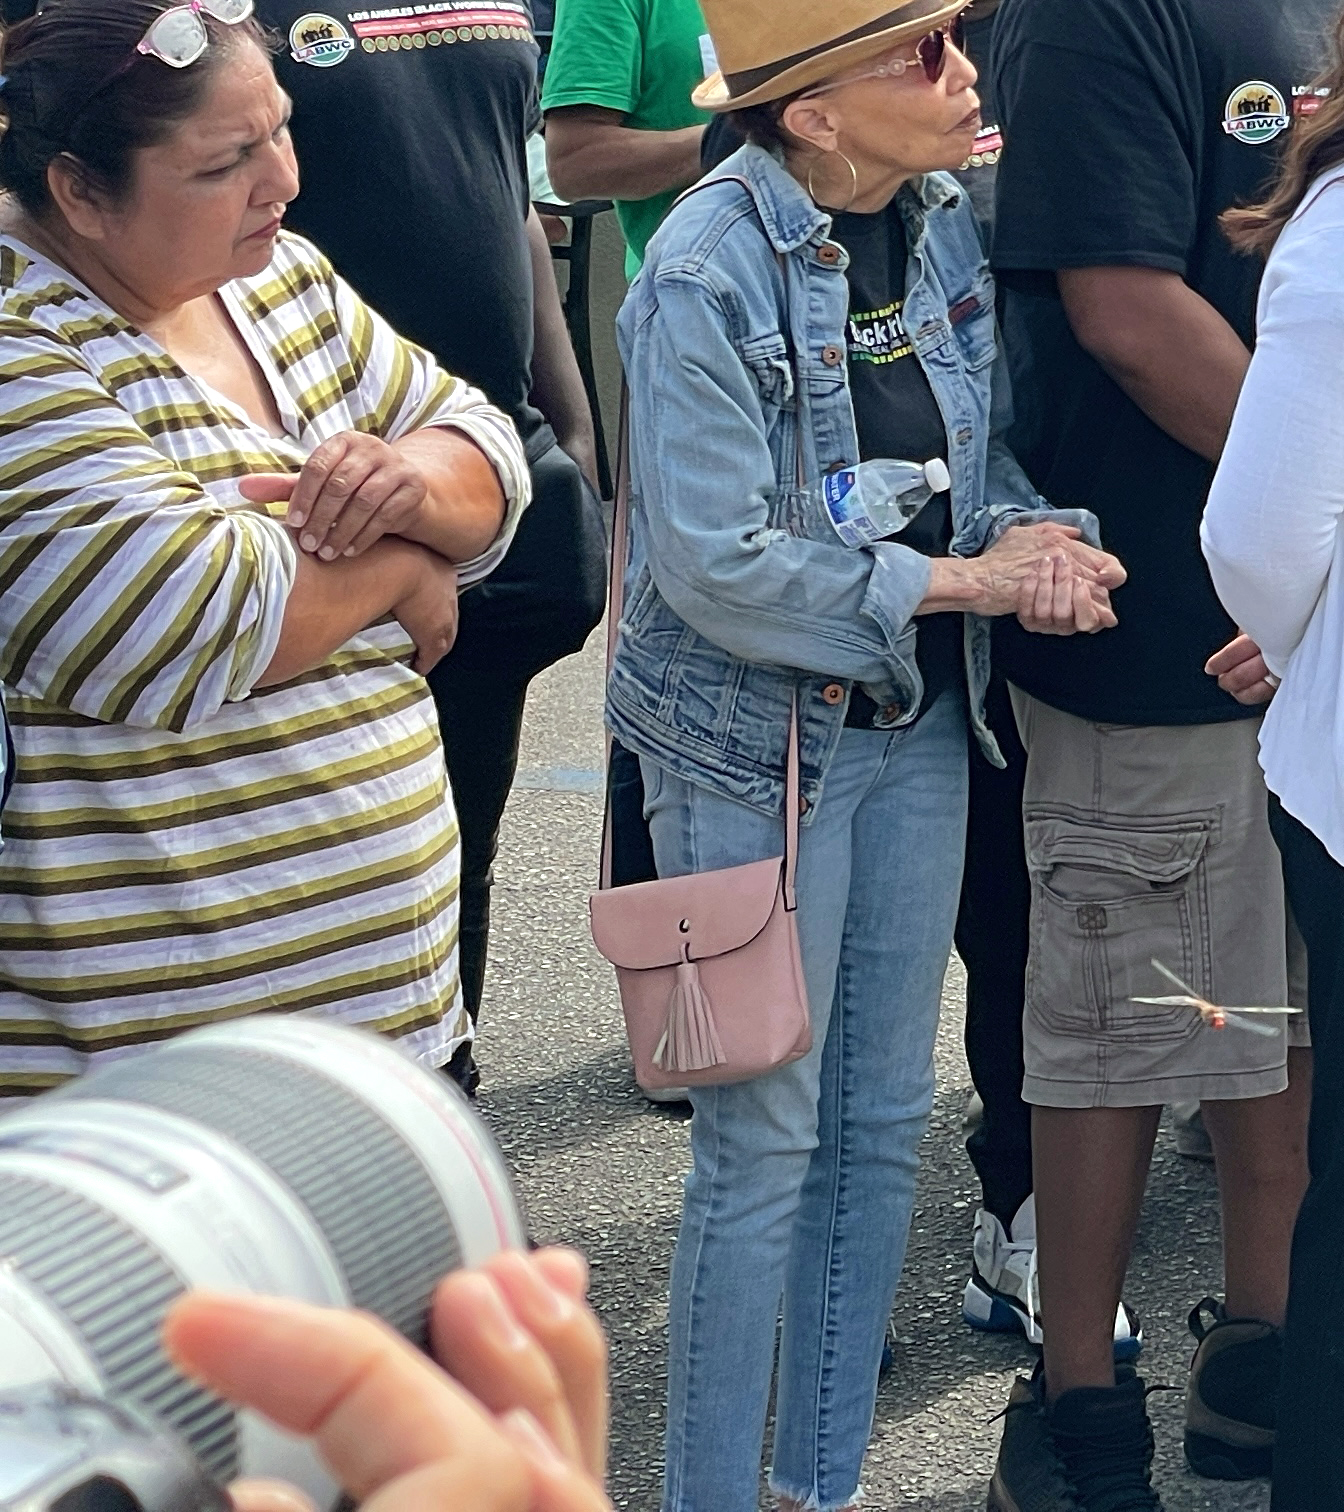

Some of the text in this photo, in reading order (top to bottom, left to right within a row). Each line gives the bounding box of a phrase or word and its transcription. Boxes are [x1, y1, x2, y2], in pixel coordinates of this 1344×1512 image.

[348, 11, 370, 22] LOS
[371, 6, 414, 19] ANGELES
[414, 2, 452, 15] BLACK
[296, 39, 353, 60] LABWC
[1227, 118, 1286, 131] LABWC
